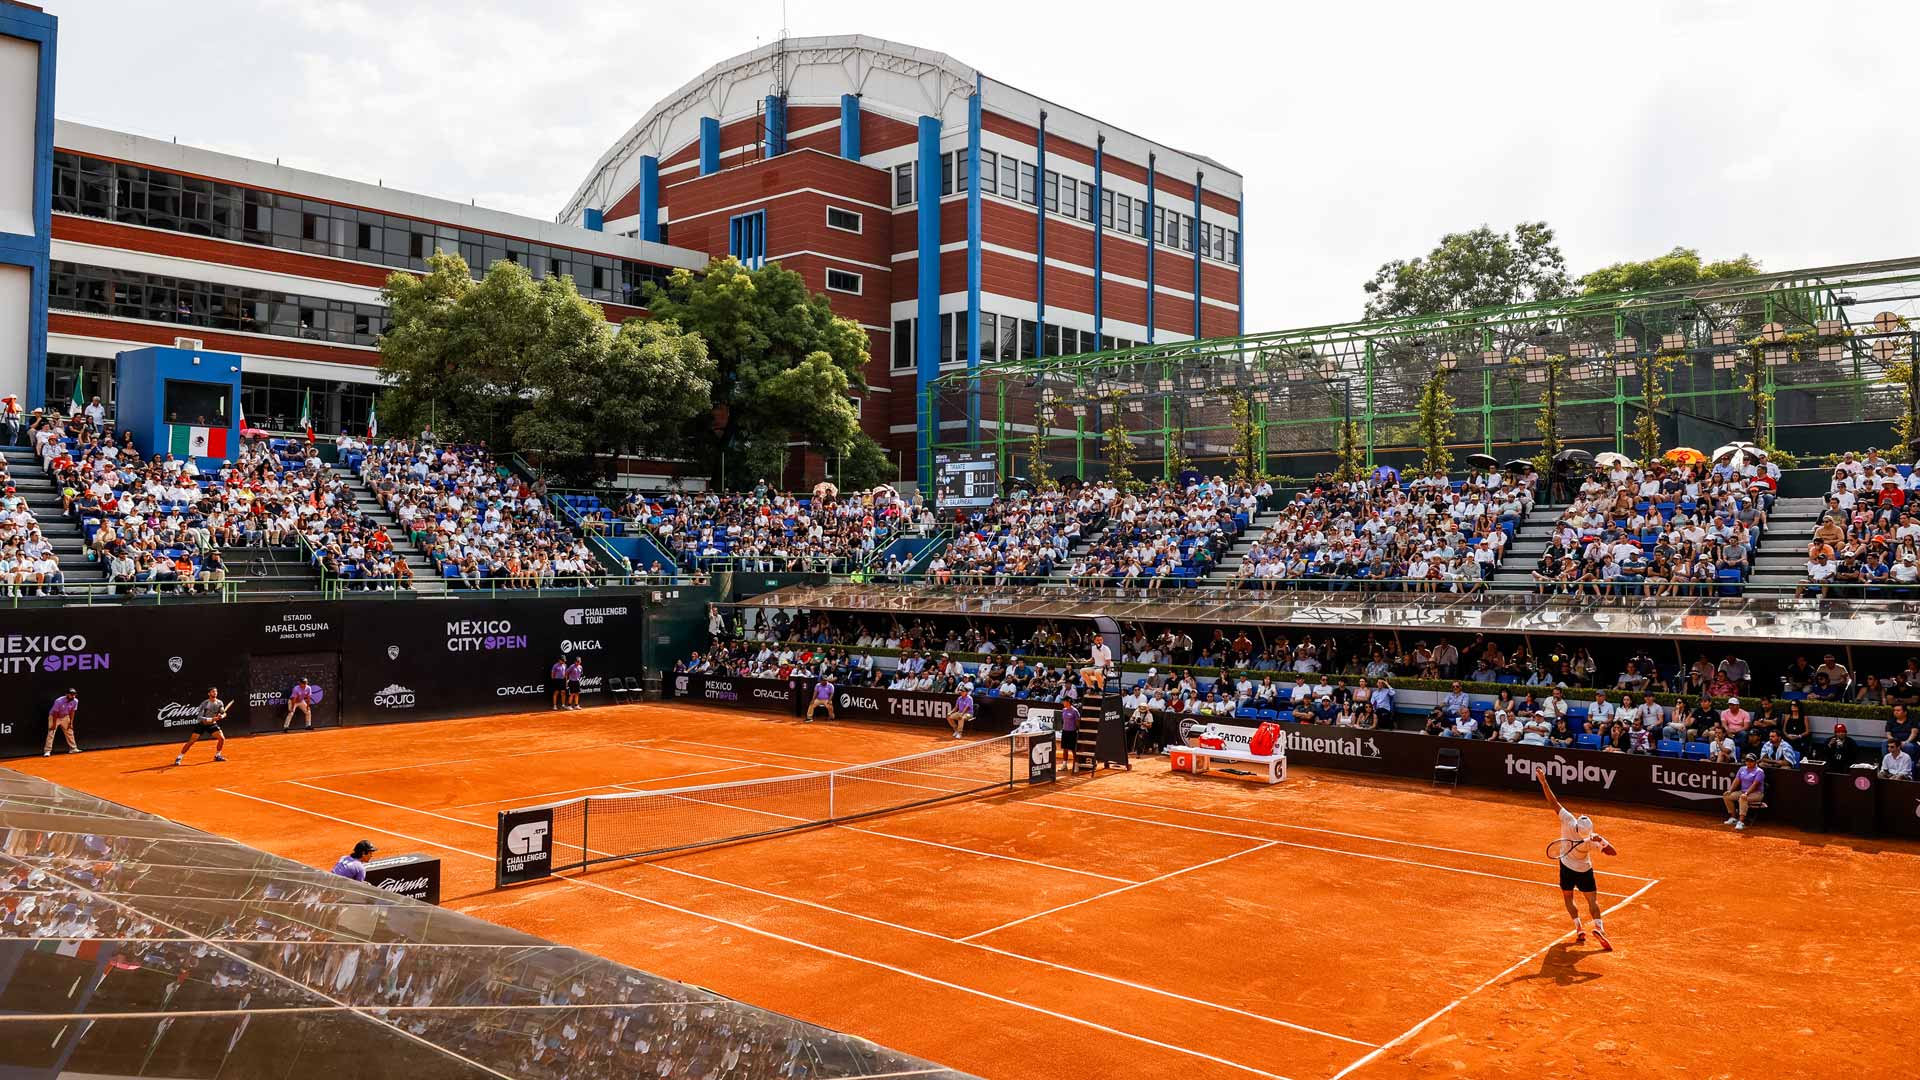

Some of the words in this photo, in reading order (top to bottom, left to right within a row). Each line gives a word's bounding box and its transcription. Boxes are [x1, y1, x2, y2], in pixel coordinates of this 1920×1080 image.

[584, 607, 628, 616] CHALLENGER
[283, 613, 312, 622] ESTADIO
[585, 616, 604, 624] TOUR
[265, 623, 298, 633] RAFAEL
[299, 622, 330, 631] OSUNA
[0, 635, 87, 654] EXICO
[447, 637, 483, 651] CITY
[484, 635, 527, 649] OPEN
[572, 640, 601, 650] MEGA
[0, 656, 42, 674] ITY
[43, 653, 110, 672] OPEN
[496, 684, 545, 696] ORACLE
[705, 681, 732, 691] MEXICO
[250, 692, 282, 700] MEXICO
[705, 689, 720, 699] CITY
[753, 688, 789, 700] ORACLE
[850, 697, 878, 710] MEGA
[157, 702, 200, 721] Calien
[1284, 731, 1362, 757] tinental
[1176, 756, 1185, 767] G
[1274, 760, 1283, 779] G
[1651, 764, 1732, 791] Eucerin
[1807, 774, 1816, 783] 2
[506, 852, 547, 865] CHALLENGER
[506, 863, 524, 873] TOUR
